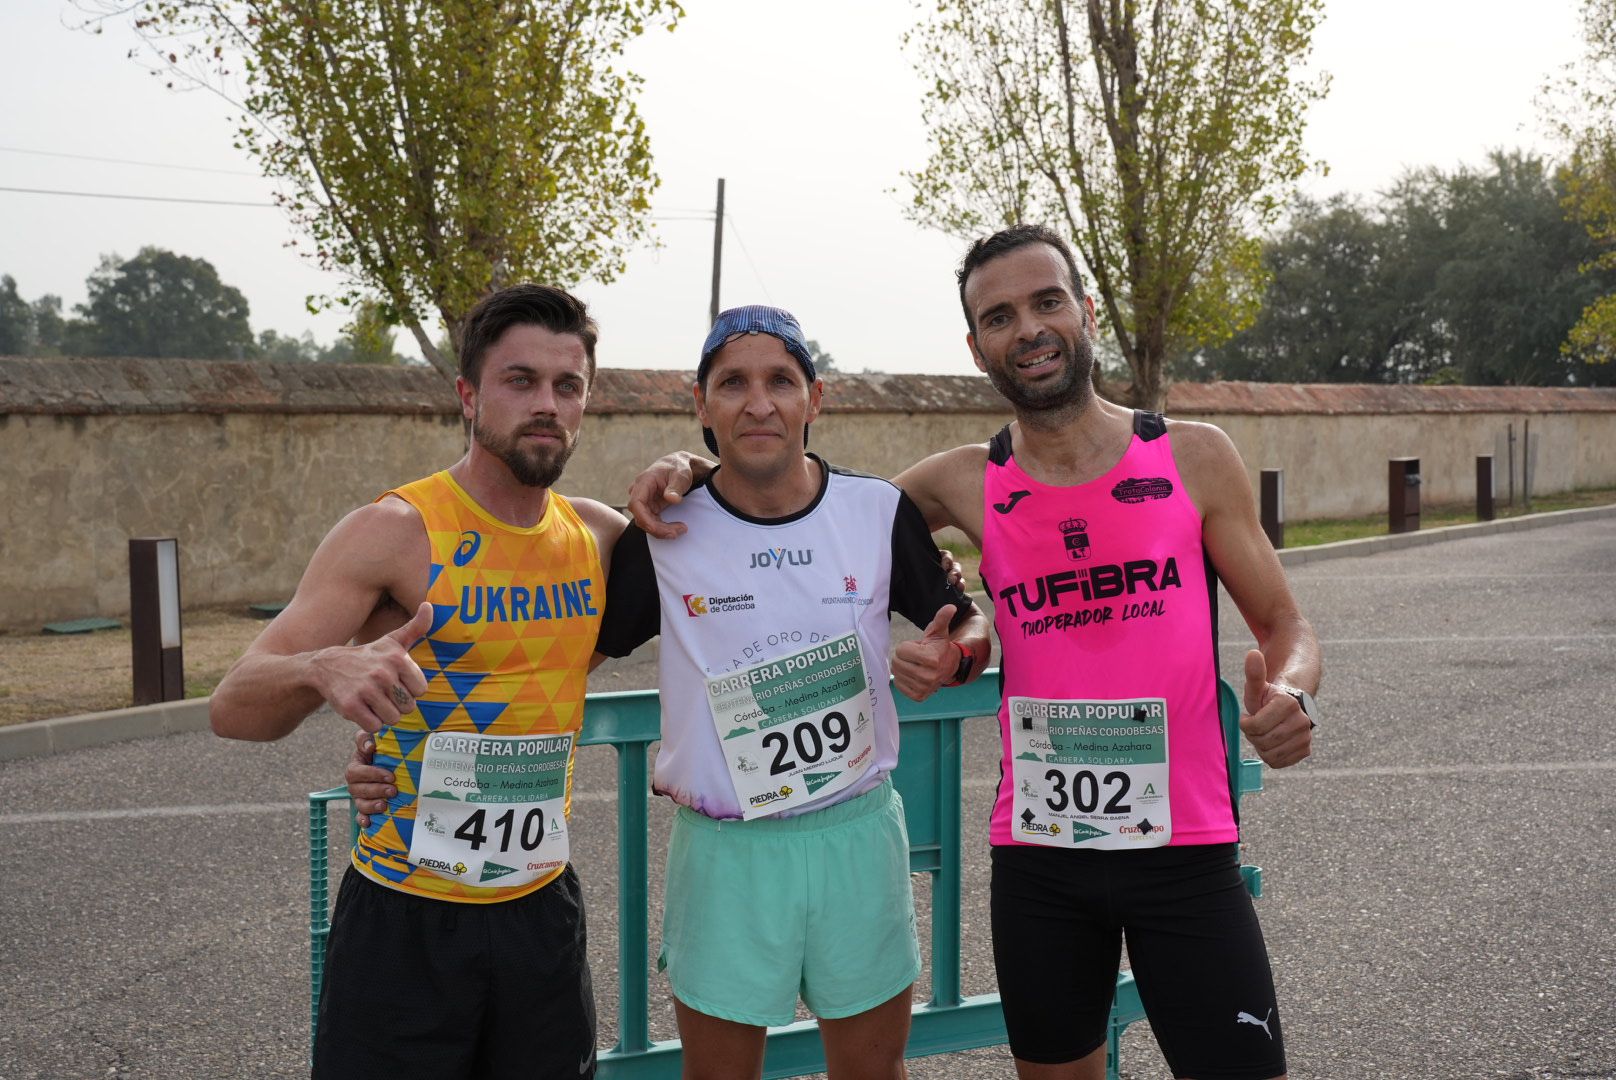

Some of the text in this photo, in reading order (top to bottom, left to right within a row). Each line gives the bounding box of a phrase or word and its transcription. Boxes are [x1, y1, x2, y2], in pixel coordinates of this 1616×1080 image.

[750, 549, 812, 570] JOYLU
[459, 578, 598, 624] UKRAINE
[708, 594, 754, 605] Diputación
[722, 603, 755, 612] Córdoba
[1122, 599, 1166, 621] LOCAL
[742, 641, 763, 659] DE
[767, 630, 803, 646] ORO
[710, 636, 857, 697] CARRERA POPULAR
[773, 678, 804, 695] PEÑAS
[805, 656, 862, 684] CORDOBESAS
[734, 705, 776, 723] Córdoba
[784, 691, 819, 708] Medina
[820, 675, 857, 695] Azahara
[761, 694, 845, 728] CARRERA SOLIDARIA
[1014, 702, 1081, 719] CARRERA
[1066, 725, 1098, 736] PEÑAS
[1099, 726, 1164, 737] CORDOBESAS
[430, 737, 570, 756] CARRERA POPULAR
[762, 711, 851, 777] 209
[1029, 739, 1063, 750] Córdoba
[1073, 742, 1109, 751] Medina
[1112, 742, 1152, 752] Azahara
[496, 762, 526, 774] PEÑAS
[528, 759, 567, 773] CORDOBESAS
[1048, 756, 1135, 765] CARRERA SOLIDARIA
[443, 776, 490, 789] Córdoba
[500, 780, 534, 790] Medina
[535, 778, 559, 788] Azahara
[1044, 769, 1131, 814] 302
[469, 793, 549, 803] CARRERA SOLIDARIA
[454, 807, 544, 852] 410
[526, 860, 563, 871] Cruzcampo
